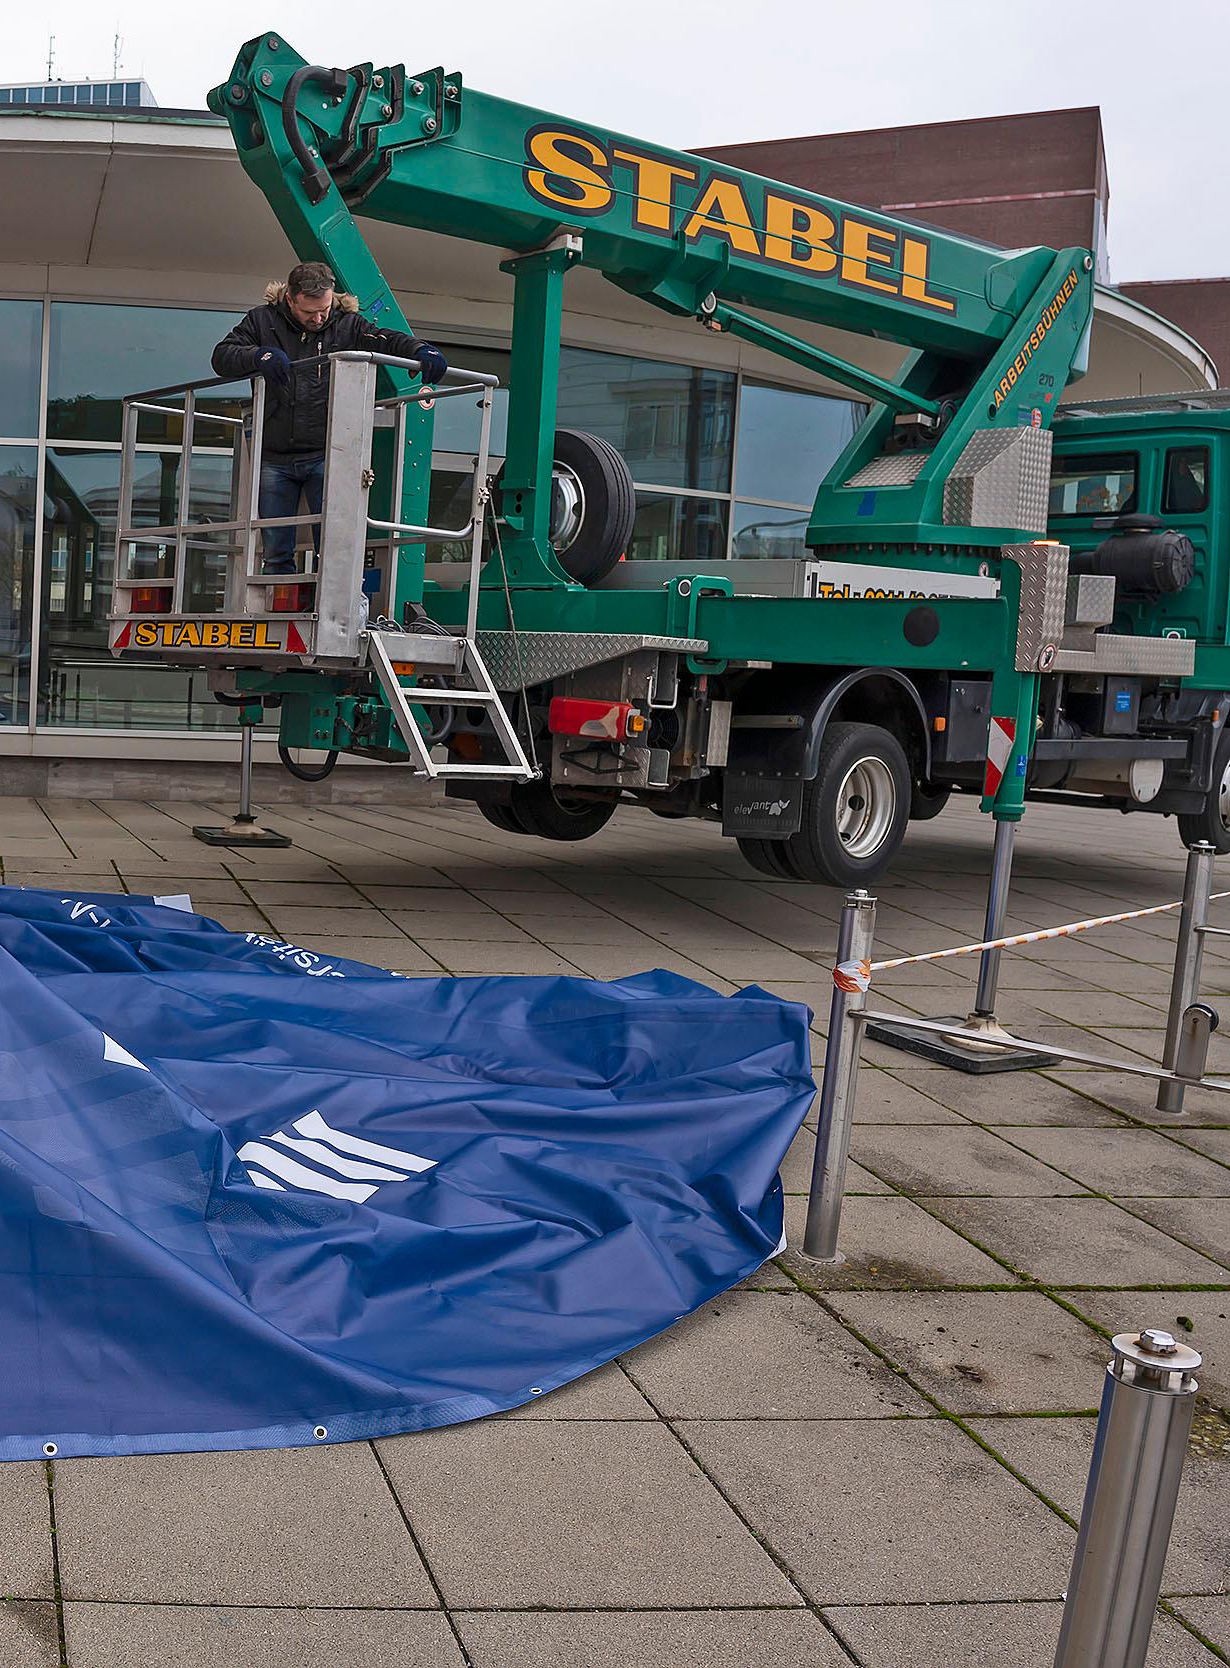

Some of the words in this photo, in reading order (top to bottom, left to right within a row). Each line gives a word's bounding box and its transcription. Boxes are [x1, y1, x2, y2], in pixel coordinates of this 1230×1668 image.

[524, 124, 957, 316] STABEL
[993, 269, 1079, 410] ARBEITSBÜHNEN
[1038, 373, 1054, 387] 270
[135, 622, 281, 649] STABEL
